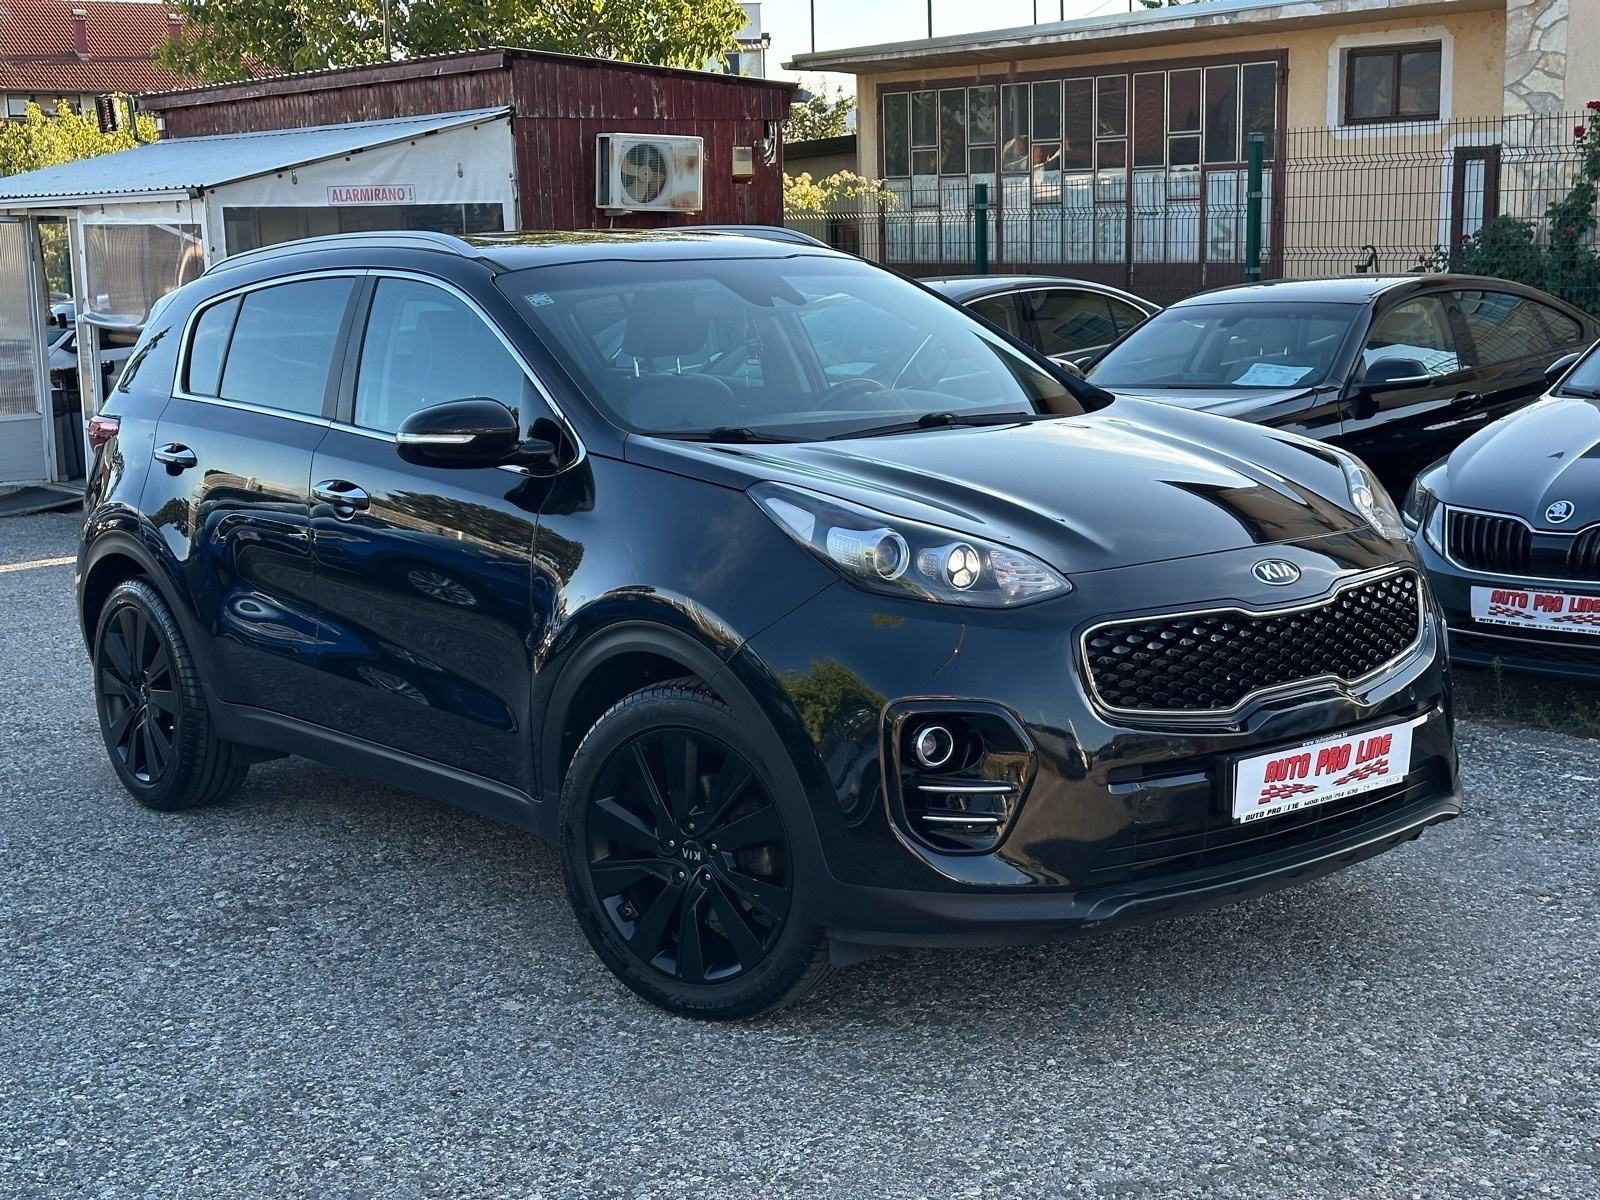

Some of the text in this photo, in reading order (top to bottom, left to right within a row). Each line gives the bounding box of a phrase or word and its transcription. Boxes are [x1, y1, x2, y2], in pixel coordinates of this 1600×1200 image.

[332, 187, 413, 202] ALARMIRANO !
[1258, 562, 1297, 580] KIA
[1490, 589, 1529, 609] AUTO
[1533, 593, 1564, 612] PRO
[1264, 733, 1393, 783] AUTO PRO LINE
[1245, 811, 1265, 821] AUTO
[1267, 806, 1282, 816] PRO
[682, 847, 701, 861] KIA
